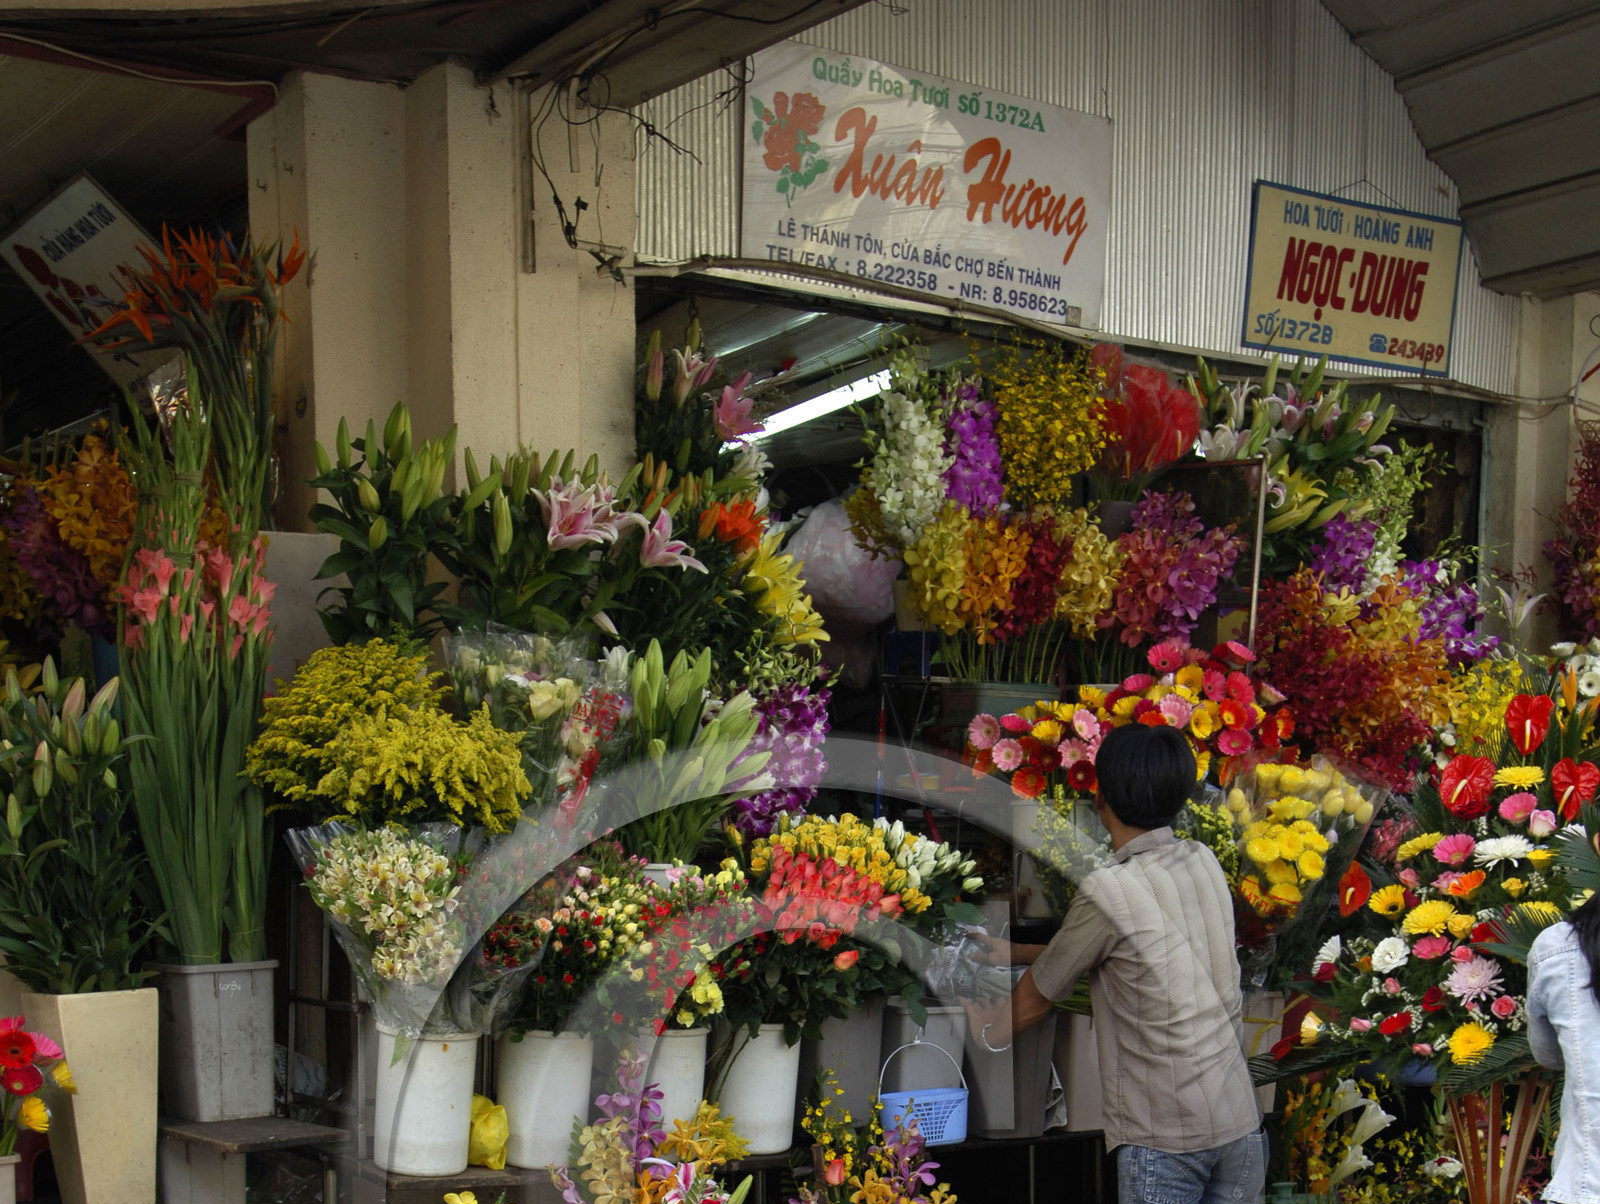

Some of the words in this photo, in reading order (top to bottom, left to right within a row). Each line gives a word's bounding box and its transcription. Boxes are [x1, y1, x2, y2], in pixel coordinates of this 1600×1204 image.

[868, 71, 903, 98] Hoa
[909, 79, 950, 109] Tươi
[984, 101, 1046, 132] 1372A
[834, 106, 945, 210] Xuân
[963, 137, 1087, 265] Hương
[778, 217, 796, 239] LÊ
[801, 224, 851, 249] THÁNH
[854, 233, 887, 259] TÔN,
[891, 238, 920, 262] CỬA
[923, 243, 951, 270] BẮC
[955, 256, 984, 278] CHỢ
[987, 257, 1014, 282] BẾN
[1018, 267, 1061, 291] THÀNH
[1283, 200, 1310, 228] HOA
[1405, 225, 1434, 251] ANH
[856, 260, 938, 292] 8.222358
[993, 286, 1068, 317] 8.958623
